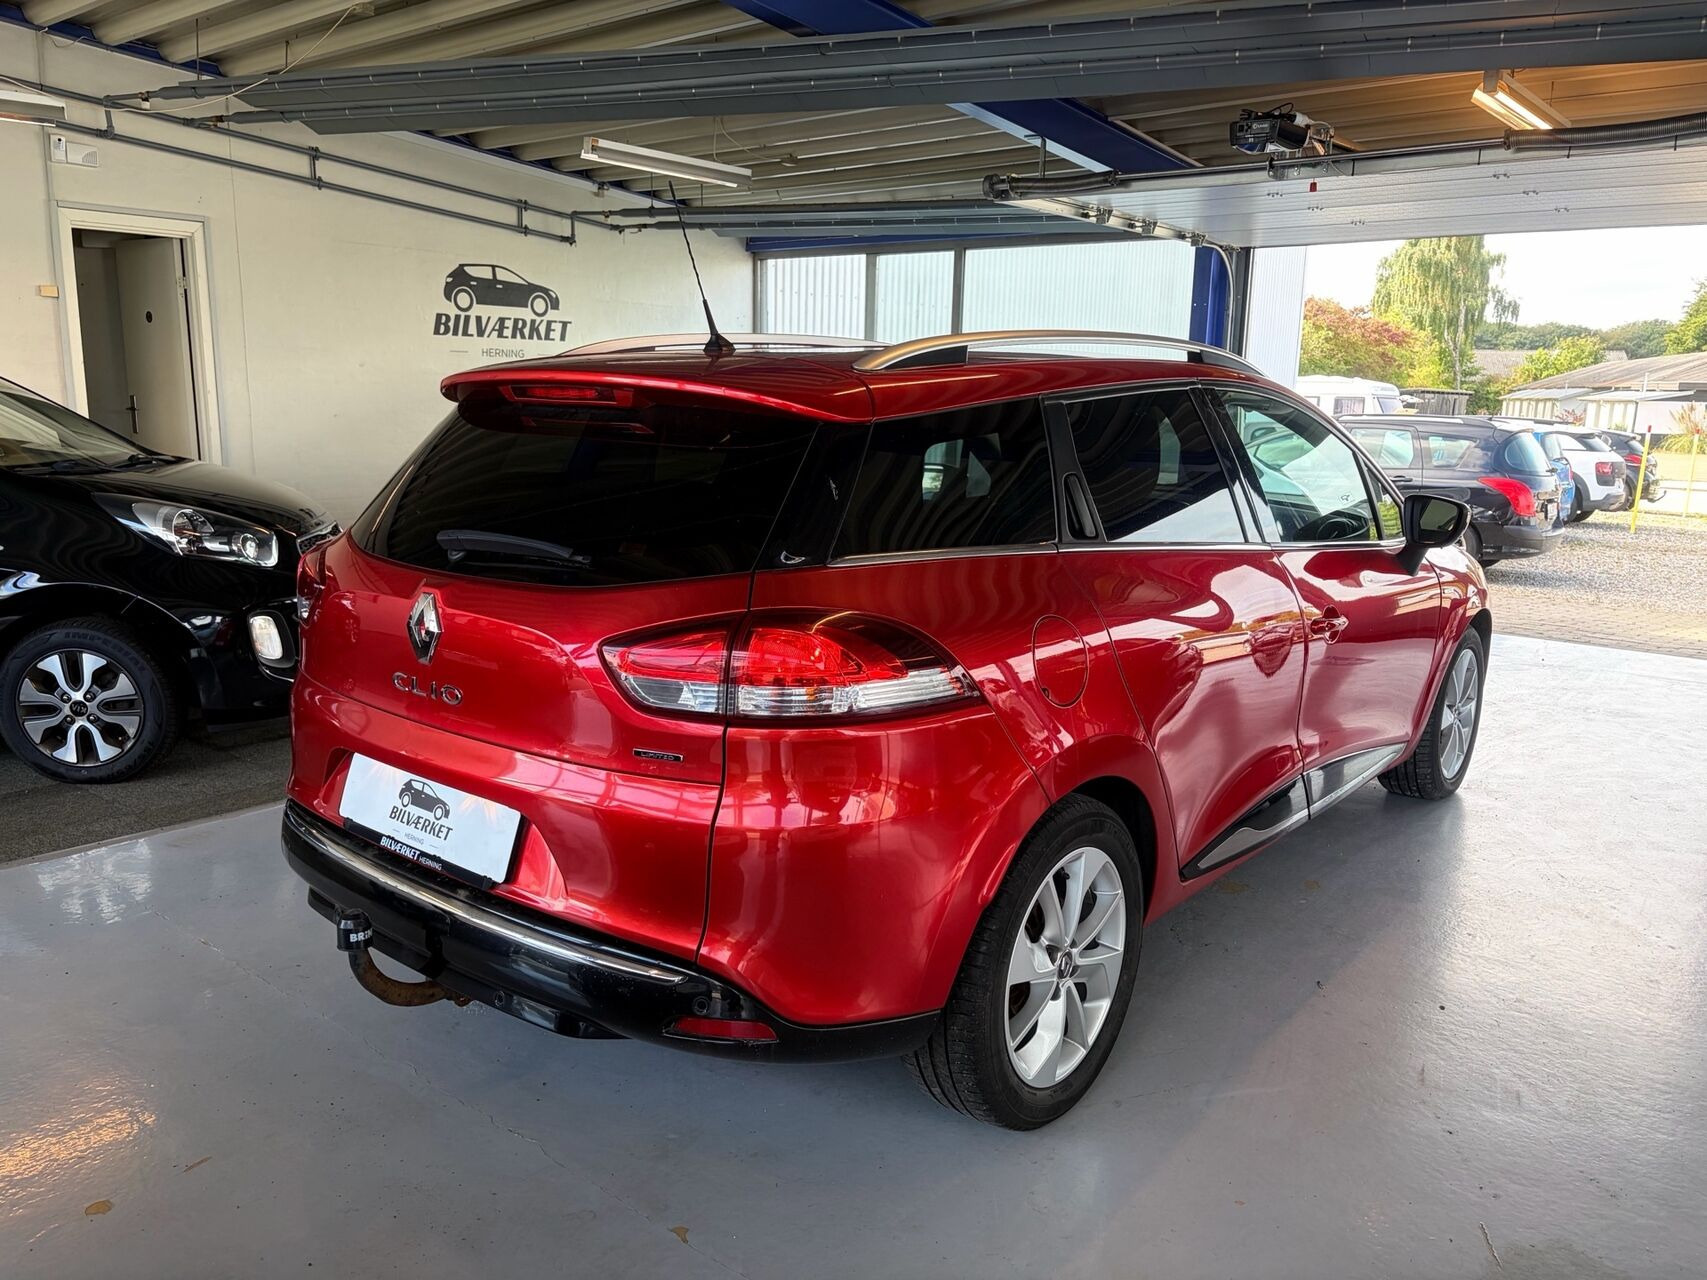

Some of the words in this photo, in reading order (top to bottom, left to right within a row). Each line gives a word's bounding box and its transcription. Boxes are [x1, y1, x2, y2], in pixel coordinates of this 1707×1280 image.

[433, 312, 572, 342] BILVÆRKET
[481, 348, 525, 358] HERNING
[392, 672, 463, 705] CLIO
[389, 805, 453, 841] BILVÆRKET
[380, 836, 420, 861] BILVÆRKET
[418, 856, 442, 871] HERNING
